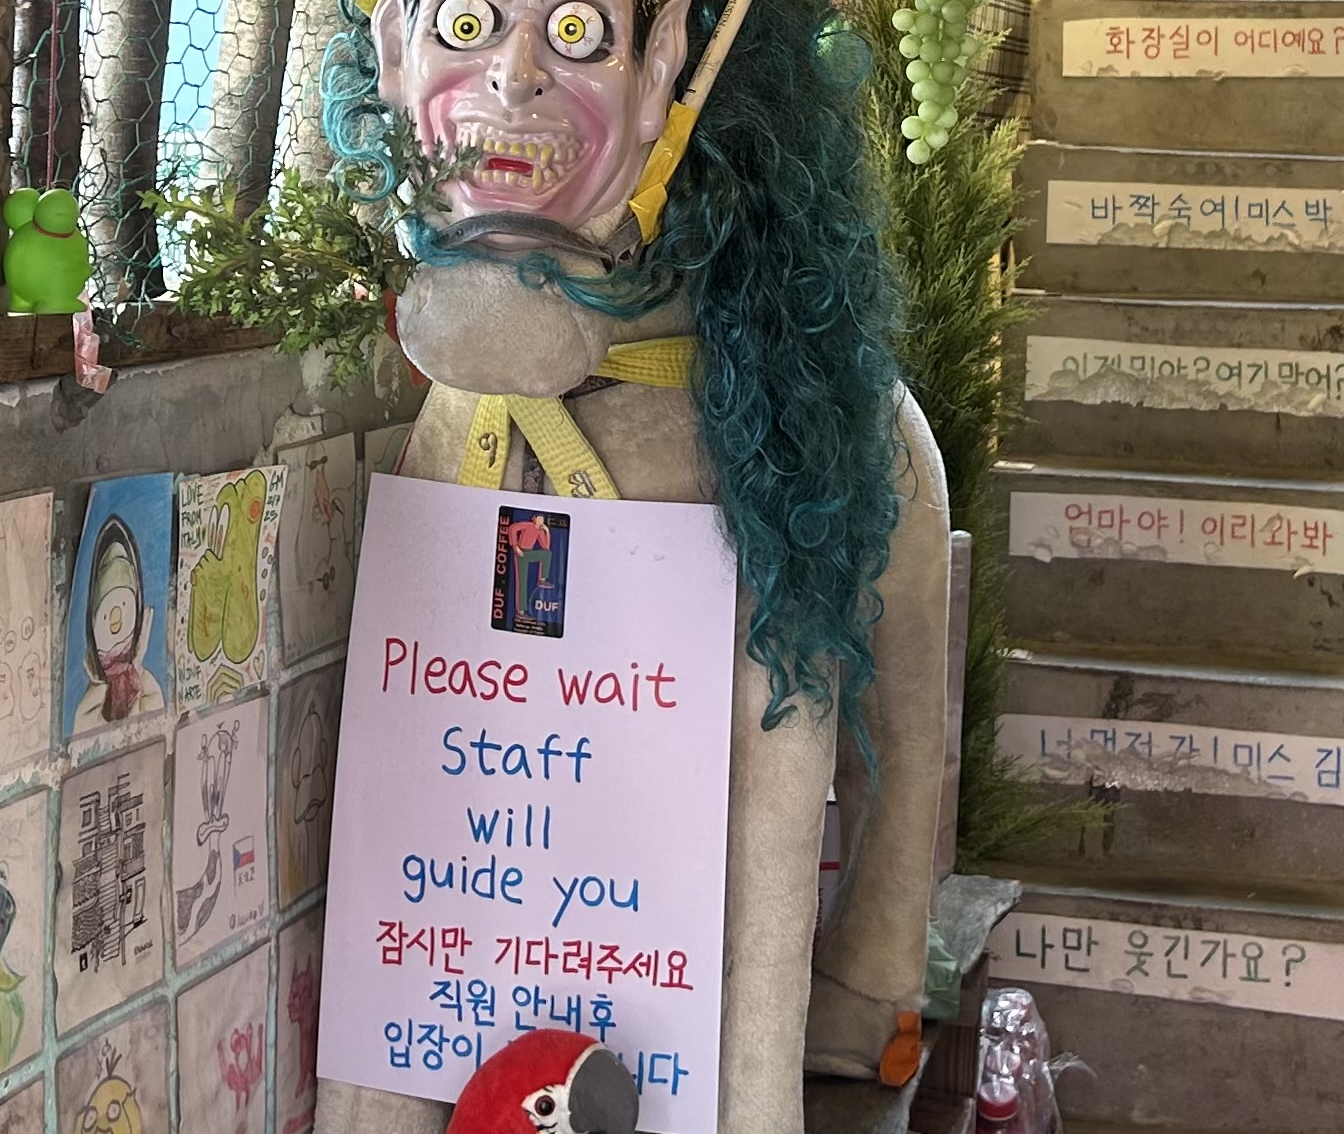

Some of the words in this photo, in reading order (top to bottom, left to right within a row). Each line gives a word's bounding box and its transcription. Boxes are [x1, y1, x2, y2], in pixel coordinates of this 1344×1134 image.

[1105, 24, 1220, 61] 화장실이
[1089, 193, 1159, 226] 바짝
[180, 508, 203, 528] FROM
[181, 482, 204, 508] LOVE
[496, 515, 511, 575] COFFEE
[1064, 502, 1186, 551] 엄마야!
[1200, 512, 1335, 557] 이리와봐
[493, 587, 506, 620] DUF
[534, 598, 560, 613] DUF
[381, 636, 531, 705] Please
[558, 660, 679, 713] wait
[442, 725, 594, 785] Staff
[1313, 745, 1343, 790] 김
[465, 803, 554, 851] will
[401, 853, 525, 905] guide
[552, 871, 641, 929] you
[375, 919, 474, 976] 잠시만
[494, 935, 695, 992] 기다려주세요
[1014, 922, 1100, 975] 나만
[1123, 928, 1308, 989] 웃긴가요?
[428, 979, 499, 1030] 직원
[510, 984, 619, 1037] 안내후
[382, 1021, 485, 1070] 입장이
